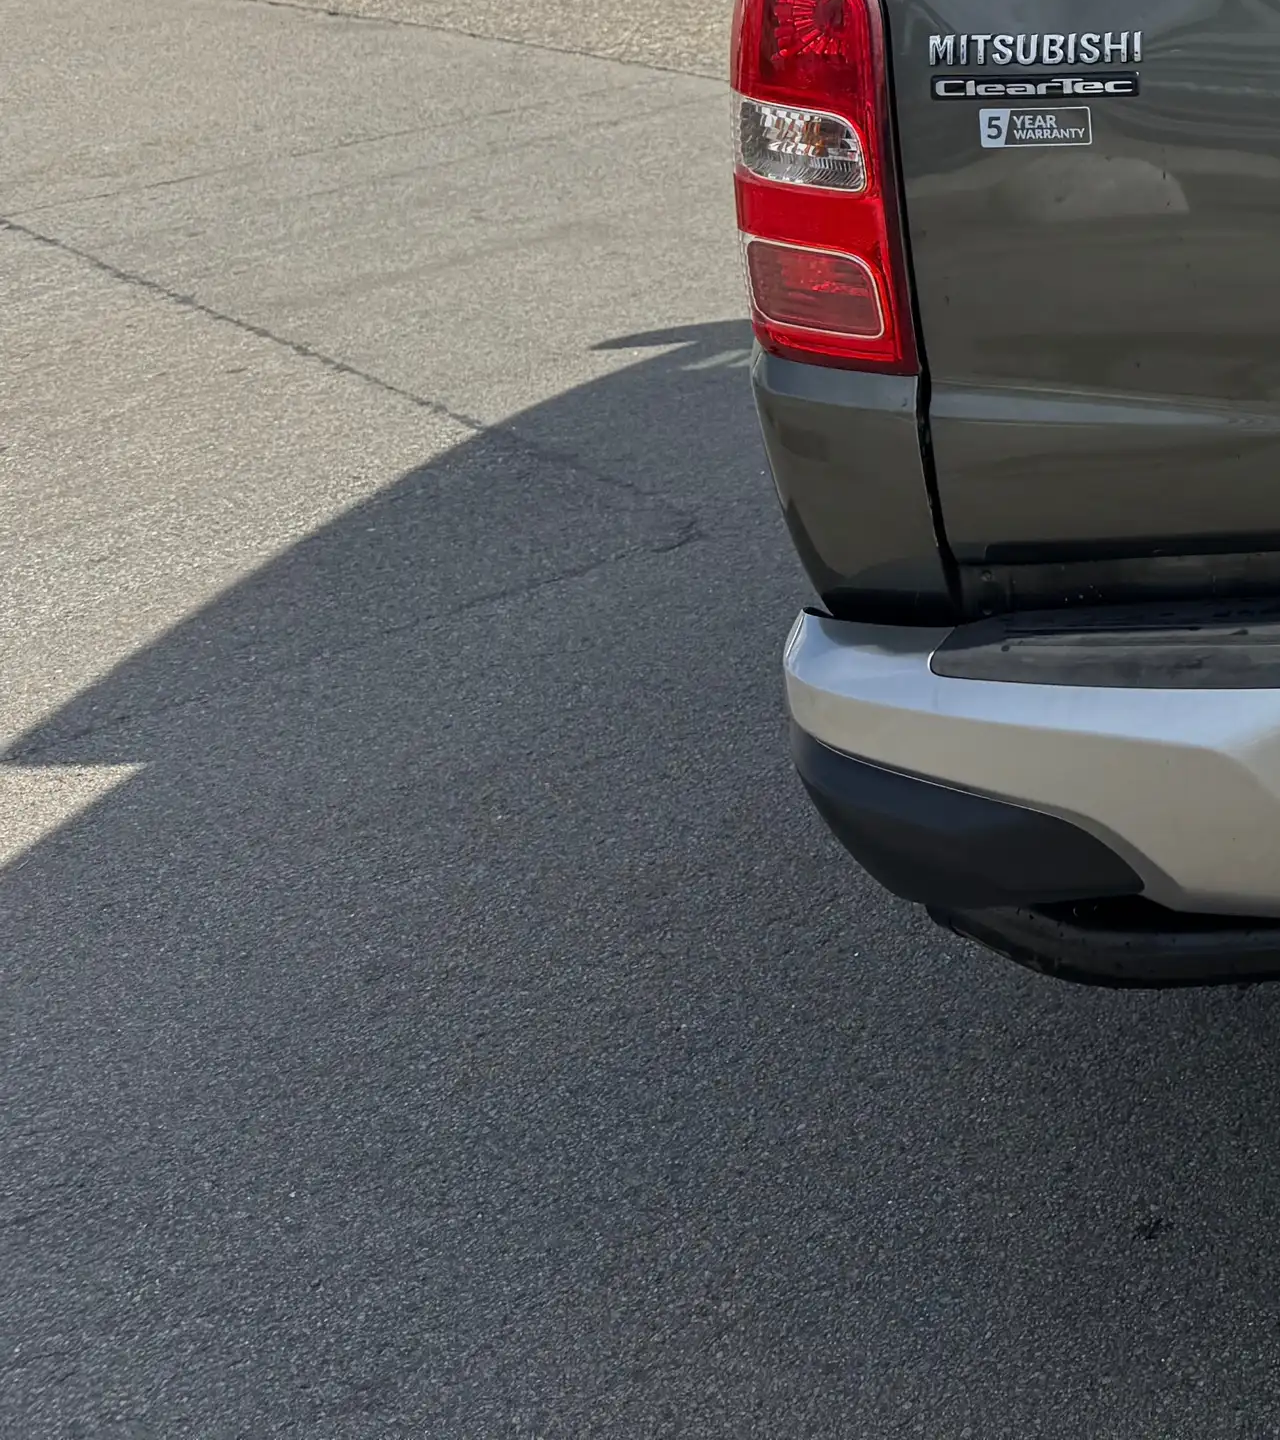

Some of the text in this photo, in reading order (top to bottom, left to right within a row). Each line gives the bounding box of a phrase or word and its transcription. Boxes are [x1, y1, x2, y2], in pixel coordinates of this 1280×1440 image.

[929, 31, 1143, 66] MITSUBISHI
[935, 78, 1133, 97] ClearTec
[987, 116, 1003, 140] 5
[1013, 114, 1058, 129] YEAR
[1013, 127, 1086, 140] WARRANTY
